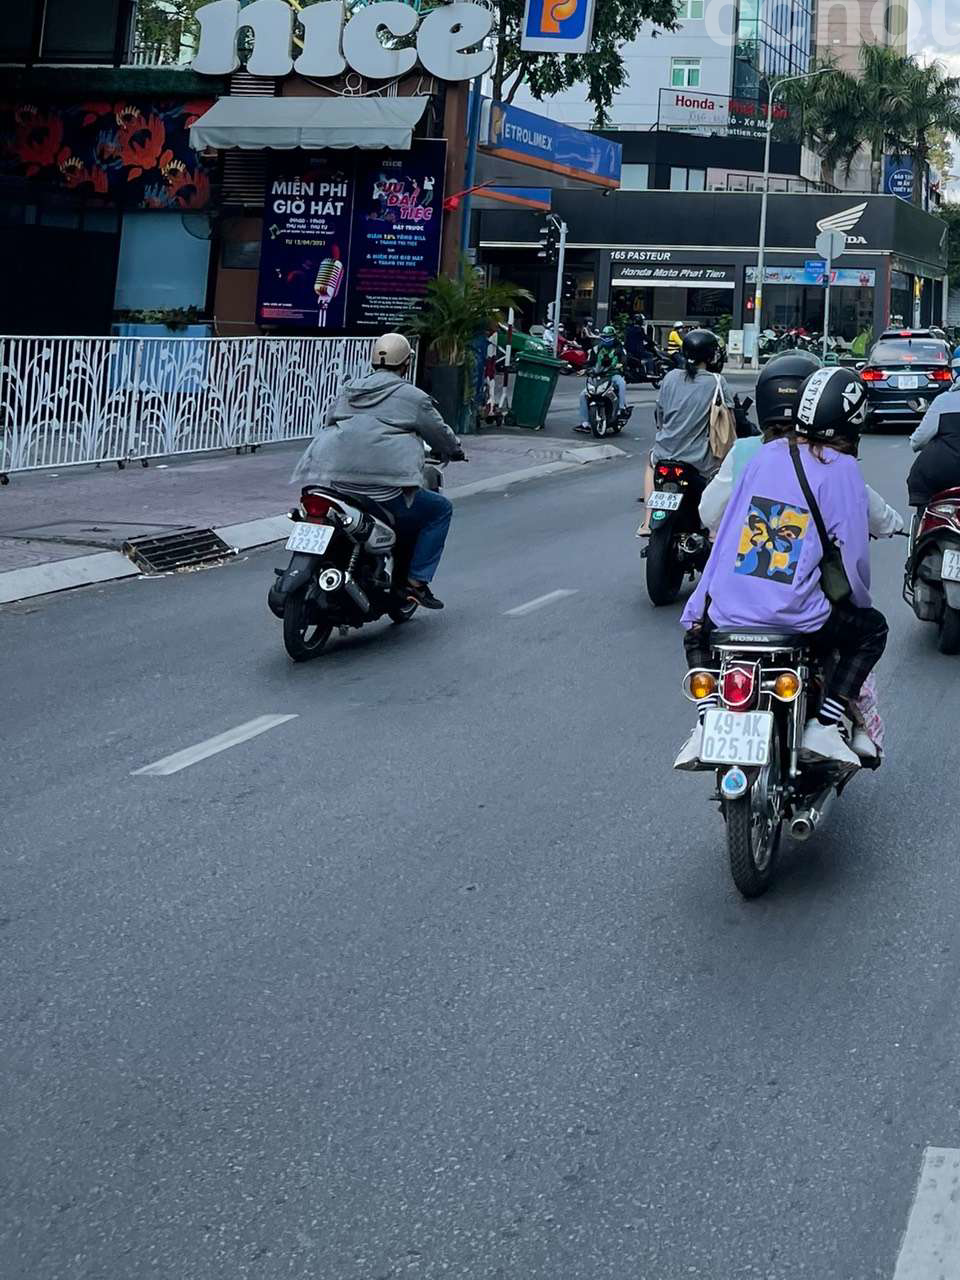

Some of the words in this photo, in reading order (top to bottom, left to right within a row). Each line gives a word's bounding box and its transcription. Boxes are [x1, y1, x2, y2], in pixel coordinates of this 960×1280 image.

[675, 95, 715, 110] Honda
[271, 176, 314, 196] MIỄN
[319, 180, 349, 197] PHÍ
[273, 196, 306, 215] GIỜ
[310, 198, 344, 216] HÁT
[610, 251, 626, 259] 165
[627, 251, 671, 261] PASTEUR
[620, 267, 652, 277] Honda
[653, 268, 678, 278] Moto
[679, 269, 703, 278] Phat
[705, 270, 726, 278] Tien
[800, 379, 822, 423] STYLE
[729, 634, 770, 642] HONDA
[713, 713, 763, 737] 49-AK
[704, 736, 767, 762] 025.16
